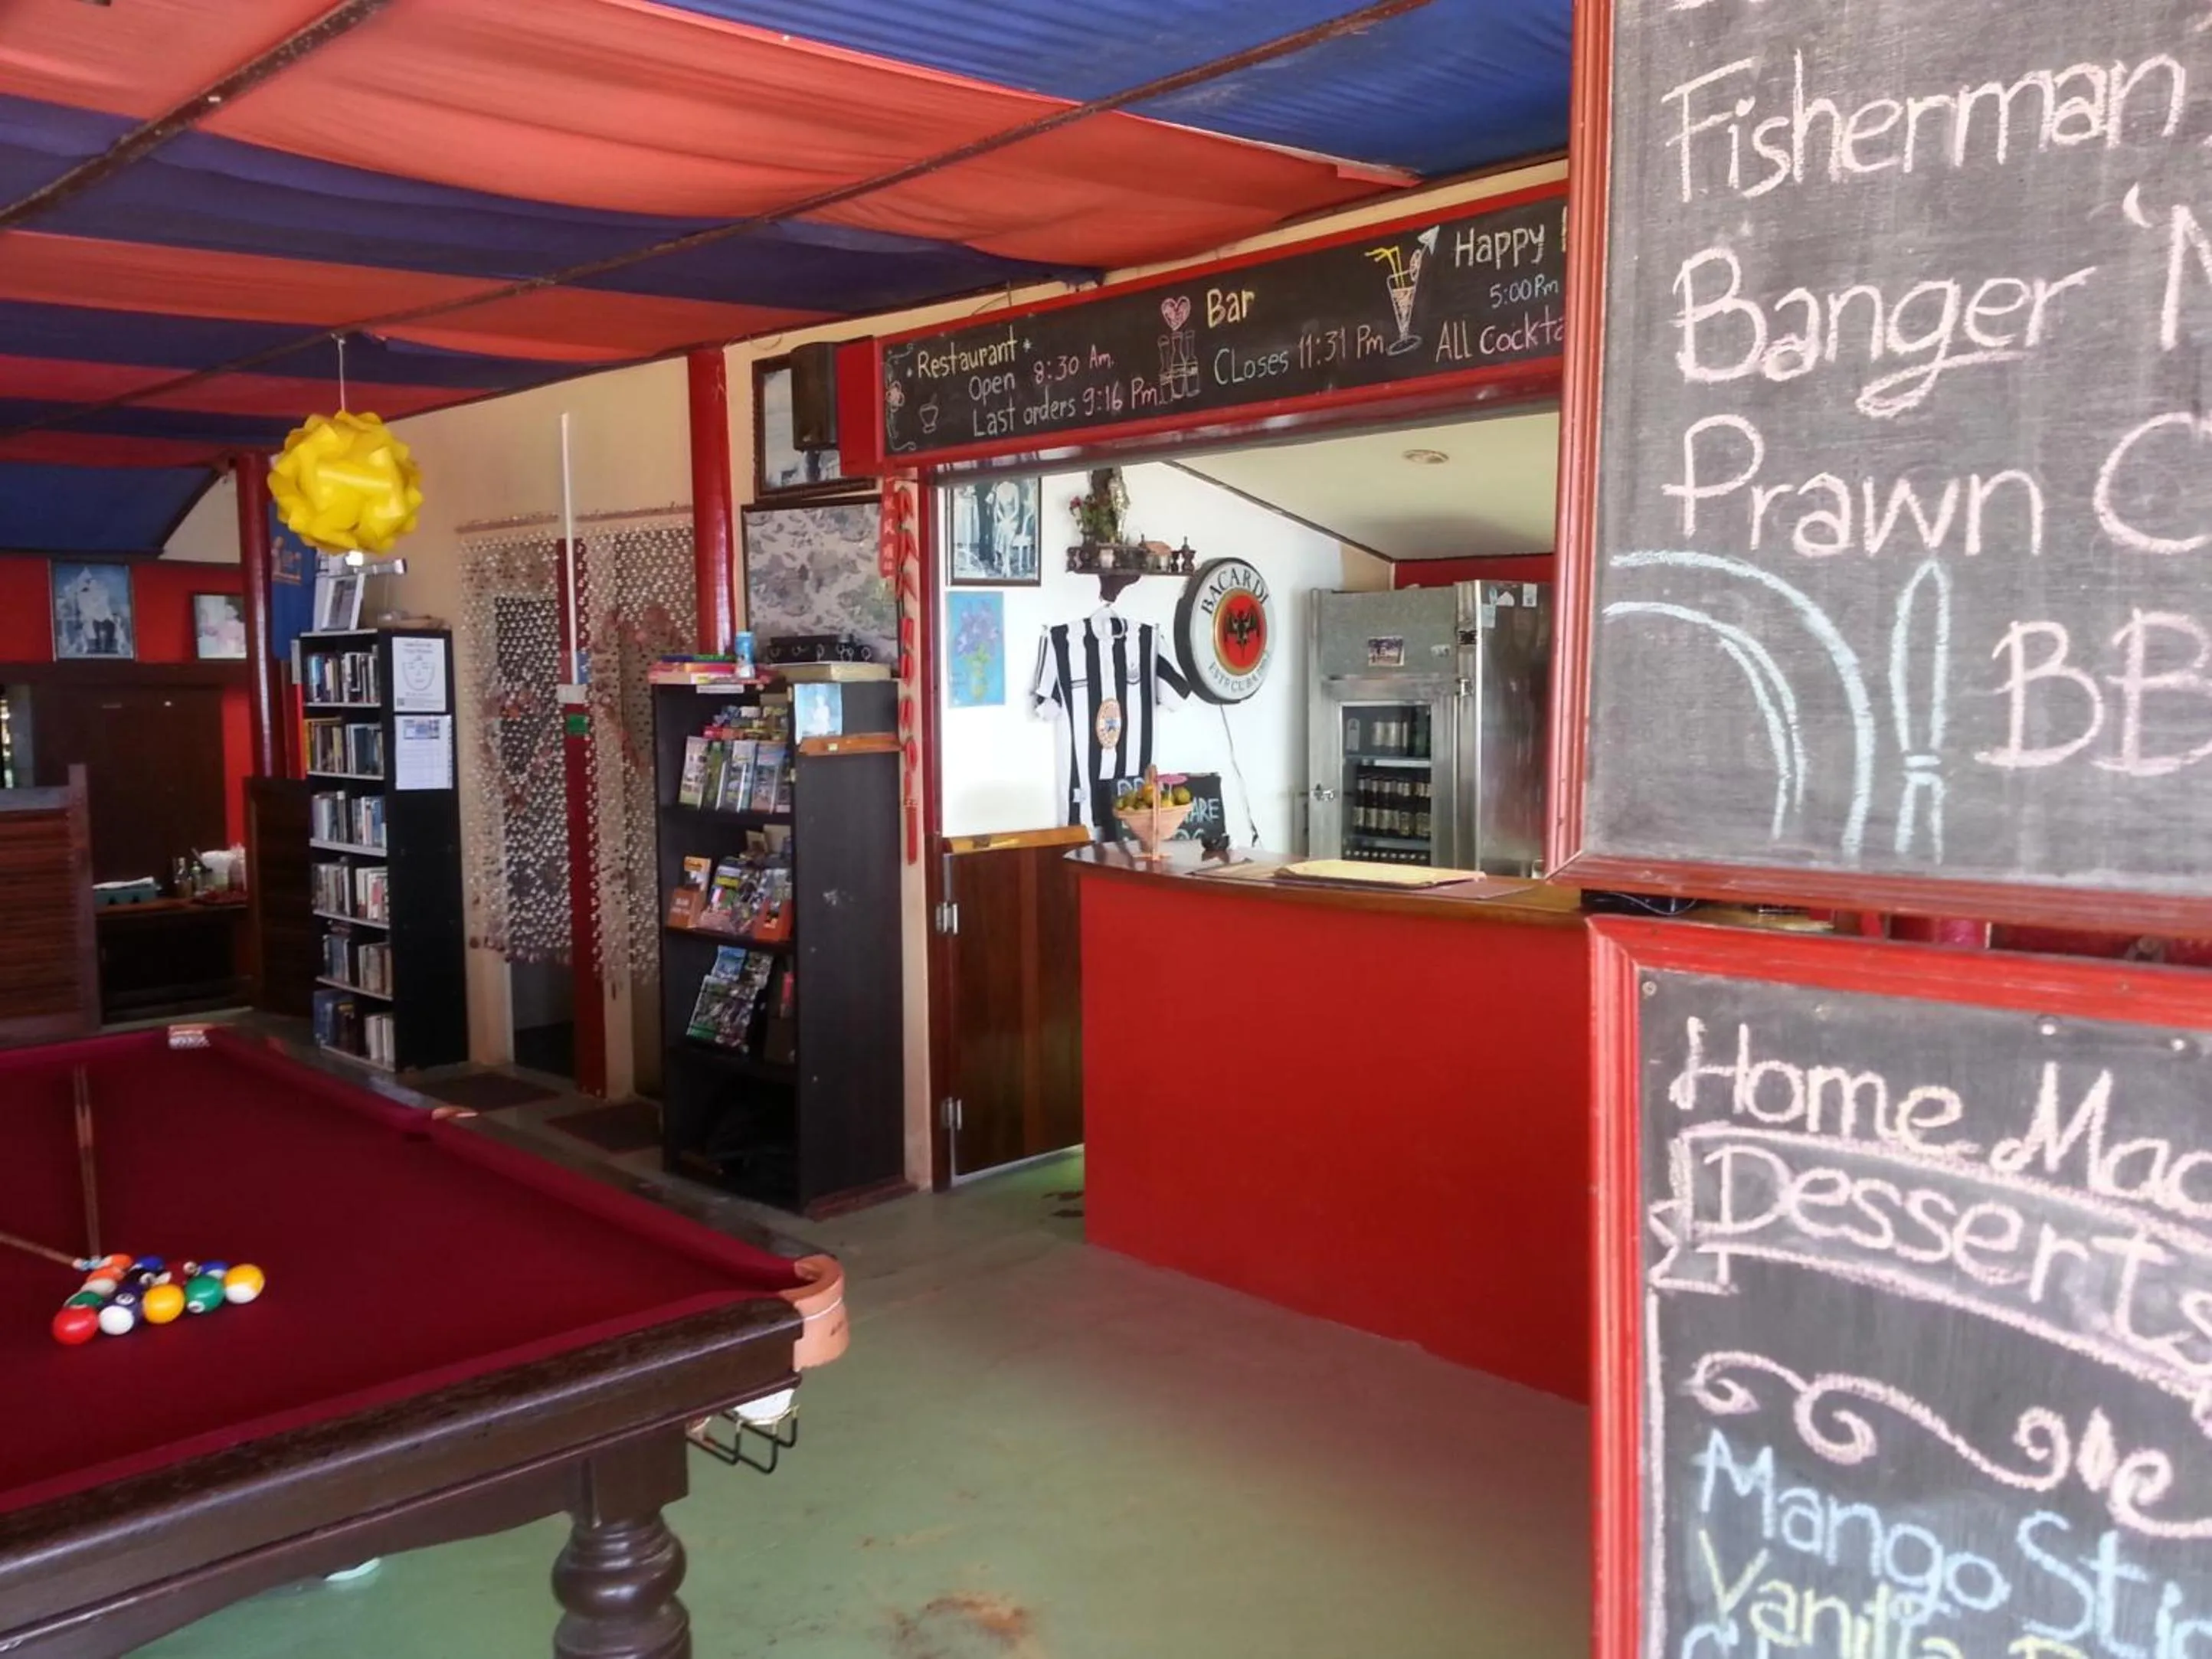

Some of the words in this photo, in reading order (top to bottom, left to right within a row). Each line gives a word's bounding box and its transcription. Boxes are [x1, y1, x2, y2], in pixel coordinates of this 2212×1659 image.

[1454, 224, 1545, 270] Happy
[1206, 288, 1255, 329] Bar
[1673, 247, 2096, 418] Banger
[918, 324, 1018, 378] Restaurant
[1298, 327, 1346, 369] 11:31
[968, 372, 1016, 407] Open
[1034, 355, 1079, 384] 8:30
[973, 396, 1016, 437] Last
[1023, 384, 1076, 425] orders
[1082, 381, 1123, 416] 9:16
[1662, 414, 2043, 558] Prawn
[1200, 568, 1270, 614] BACARDI
[1668, 1016, 1984, 1155] Home
[1690, 1427, 2011, 1630] Mango
